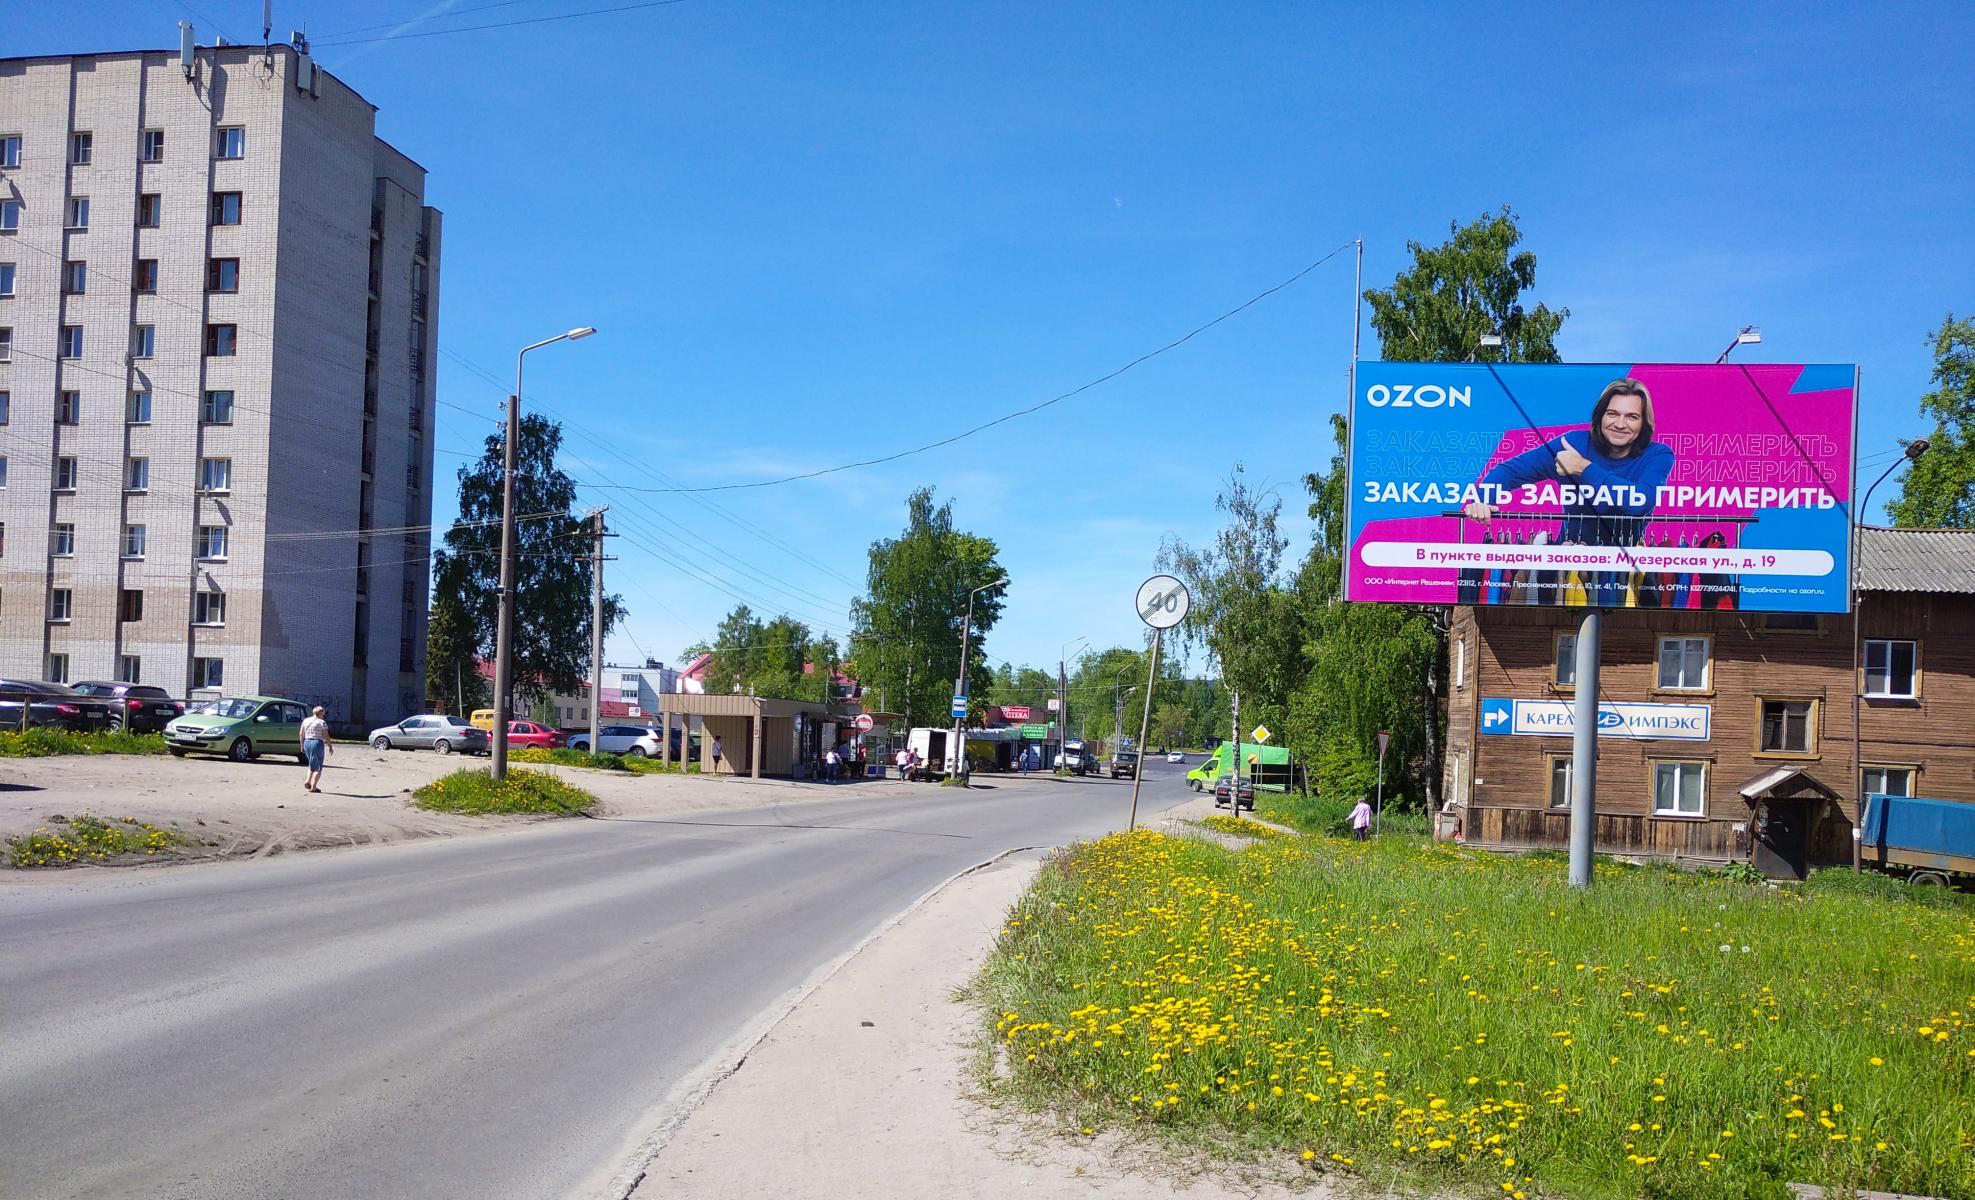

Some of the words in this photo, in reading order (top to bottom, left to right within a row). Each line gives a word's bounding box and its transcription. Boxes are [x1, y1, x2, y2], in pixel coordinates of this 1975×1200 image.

[1366, 384, 1472, 408] OZON
[1366, 430, 1515, 453] ЗАКАЗАТЬ
[1657, 433, 1838, 457] ПРИМЕРИТЬ
[1363, 481, 1513, 504] ЗАКАЗАТЬ
[1520, 484, 1647, 507] ЗАБРАТЬ
[1655, 485, 1836, 509] ПРИМЕРИТЬ
[1416, 549, 1426, 560] В
[1430, 551, 1481, 564] пункте
[1486, 553, 1542, 564] выдачи
[1546, 555, 1611, 565] заказов:
[1615, 552, 1707, 567] Муезерская
[1712, 556, 1738, 569] ул.,
[1742, 557, 1756, 568] д.
[1761, 555, 1776, 567] 19
[1739, 585, 1787, 595] Подробности
[1147, 591, 1178, 614] 40
[1629, 714, 1701, 730] ИМПЭКС
